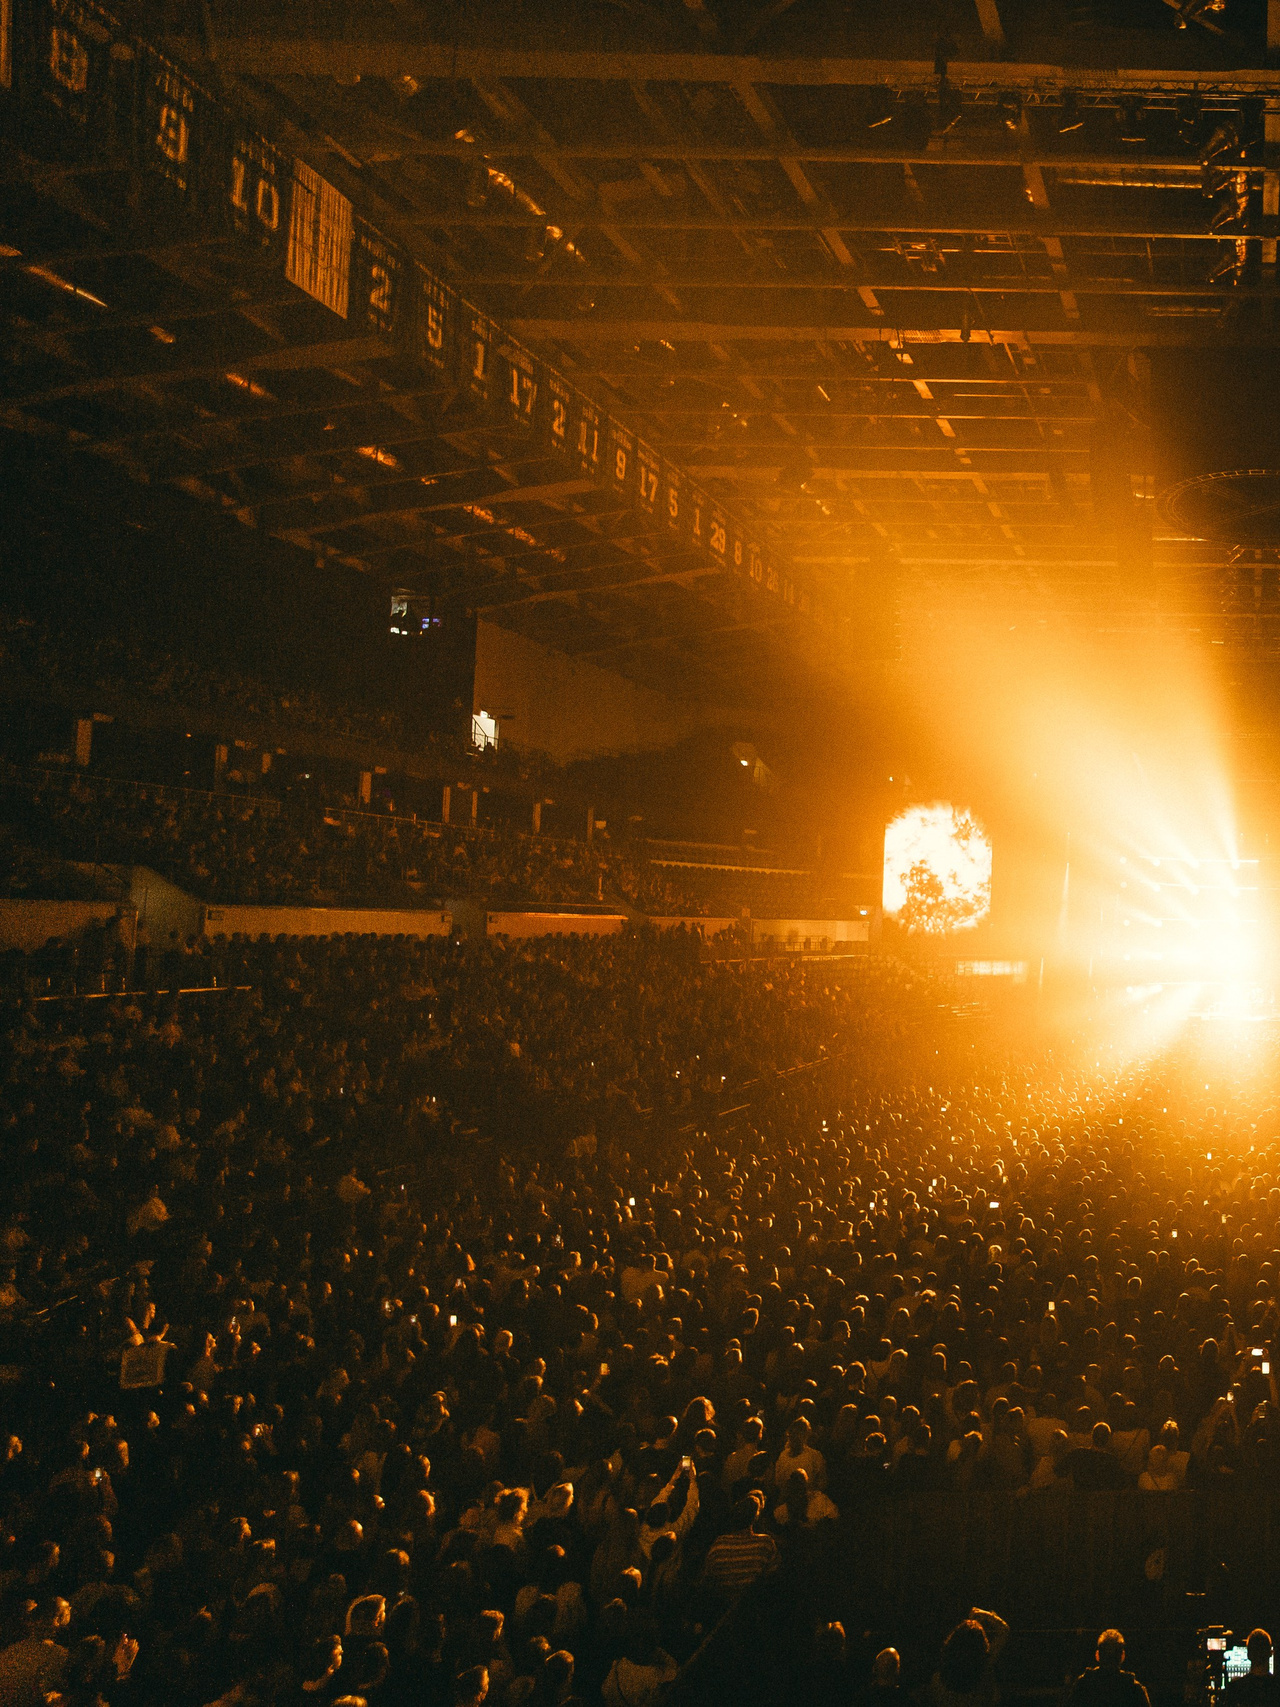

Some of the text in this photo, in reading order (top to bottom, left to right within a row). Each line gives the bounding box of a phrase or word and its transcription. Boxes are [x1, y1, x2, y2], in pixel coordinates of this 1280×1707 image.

[231, 155, 279, 230] 10
[370, 263, 391, 314] 2
[426, 303, 443, 350] 5
[472, 341, 487, 382] 1
[510, 367, 538, 415] 17
[552, 398, 567, 438] 2
[577, 421, 598, 462] 11
[640, 466, 658, 503] 17
[668, 487, 679, 518] 5
[693, 507, 701, 536] 1
